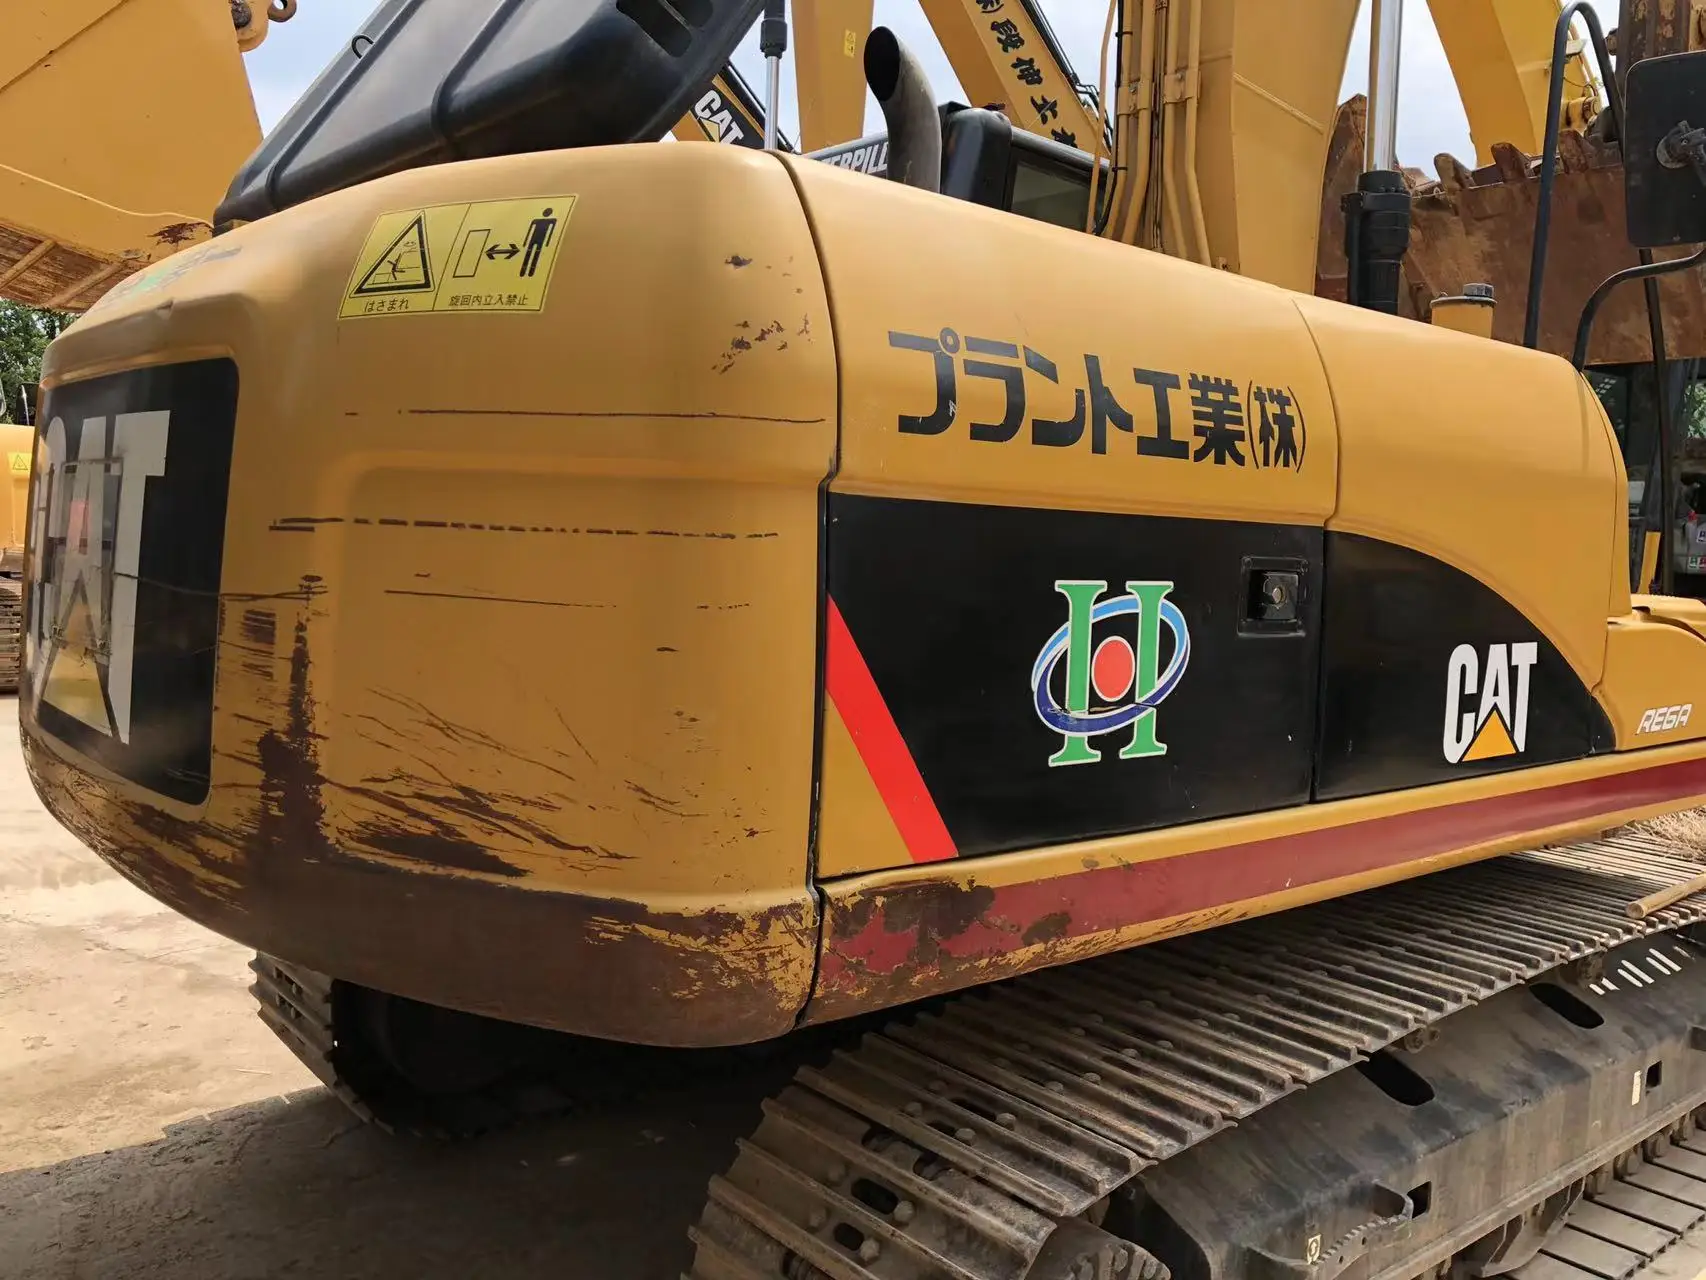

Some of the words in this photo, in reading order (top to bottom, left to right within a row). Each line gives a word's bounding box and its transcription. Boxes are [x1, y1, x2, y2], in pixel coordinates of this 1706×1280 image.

[694, 89, 745, 144] CAT
[364, 297, 409, 313] はさまれ
[448, 293, 529, 307] 旋回内立入禁止
[29, 409, 171, 746] CAT
[1443, 641, 1538, 764] CAT
